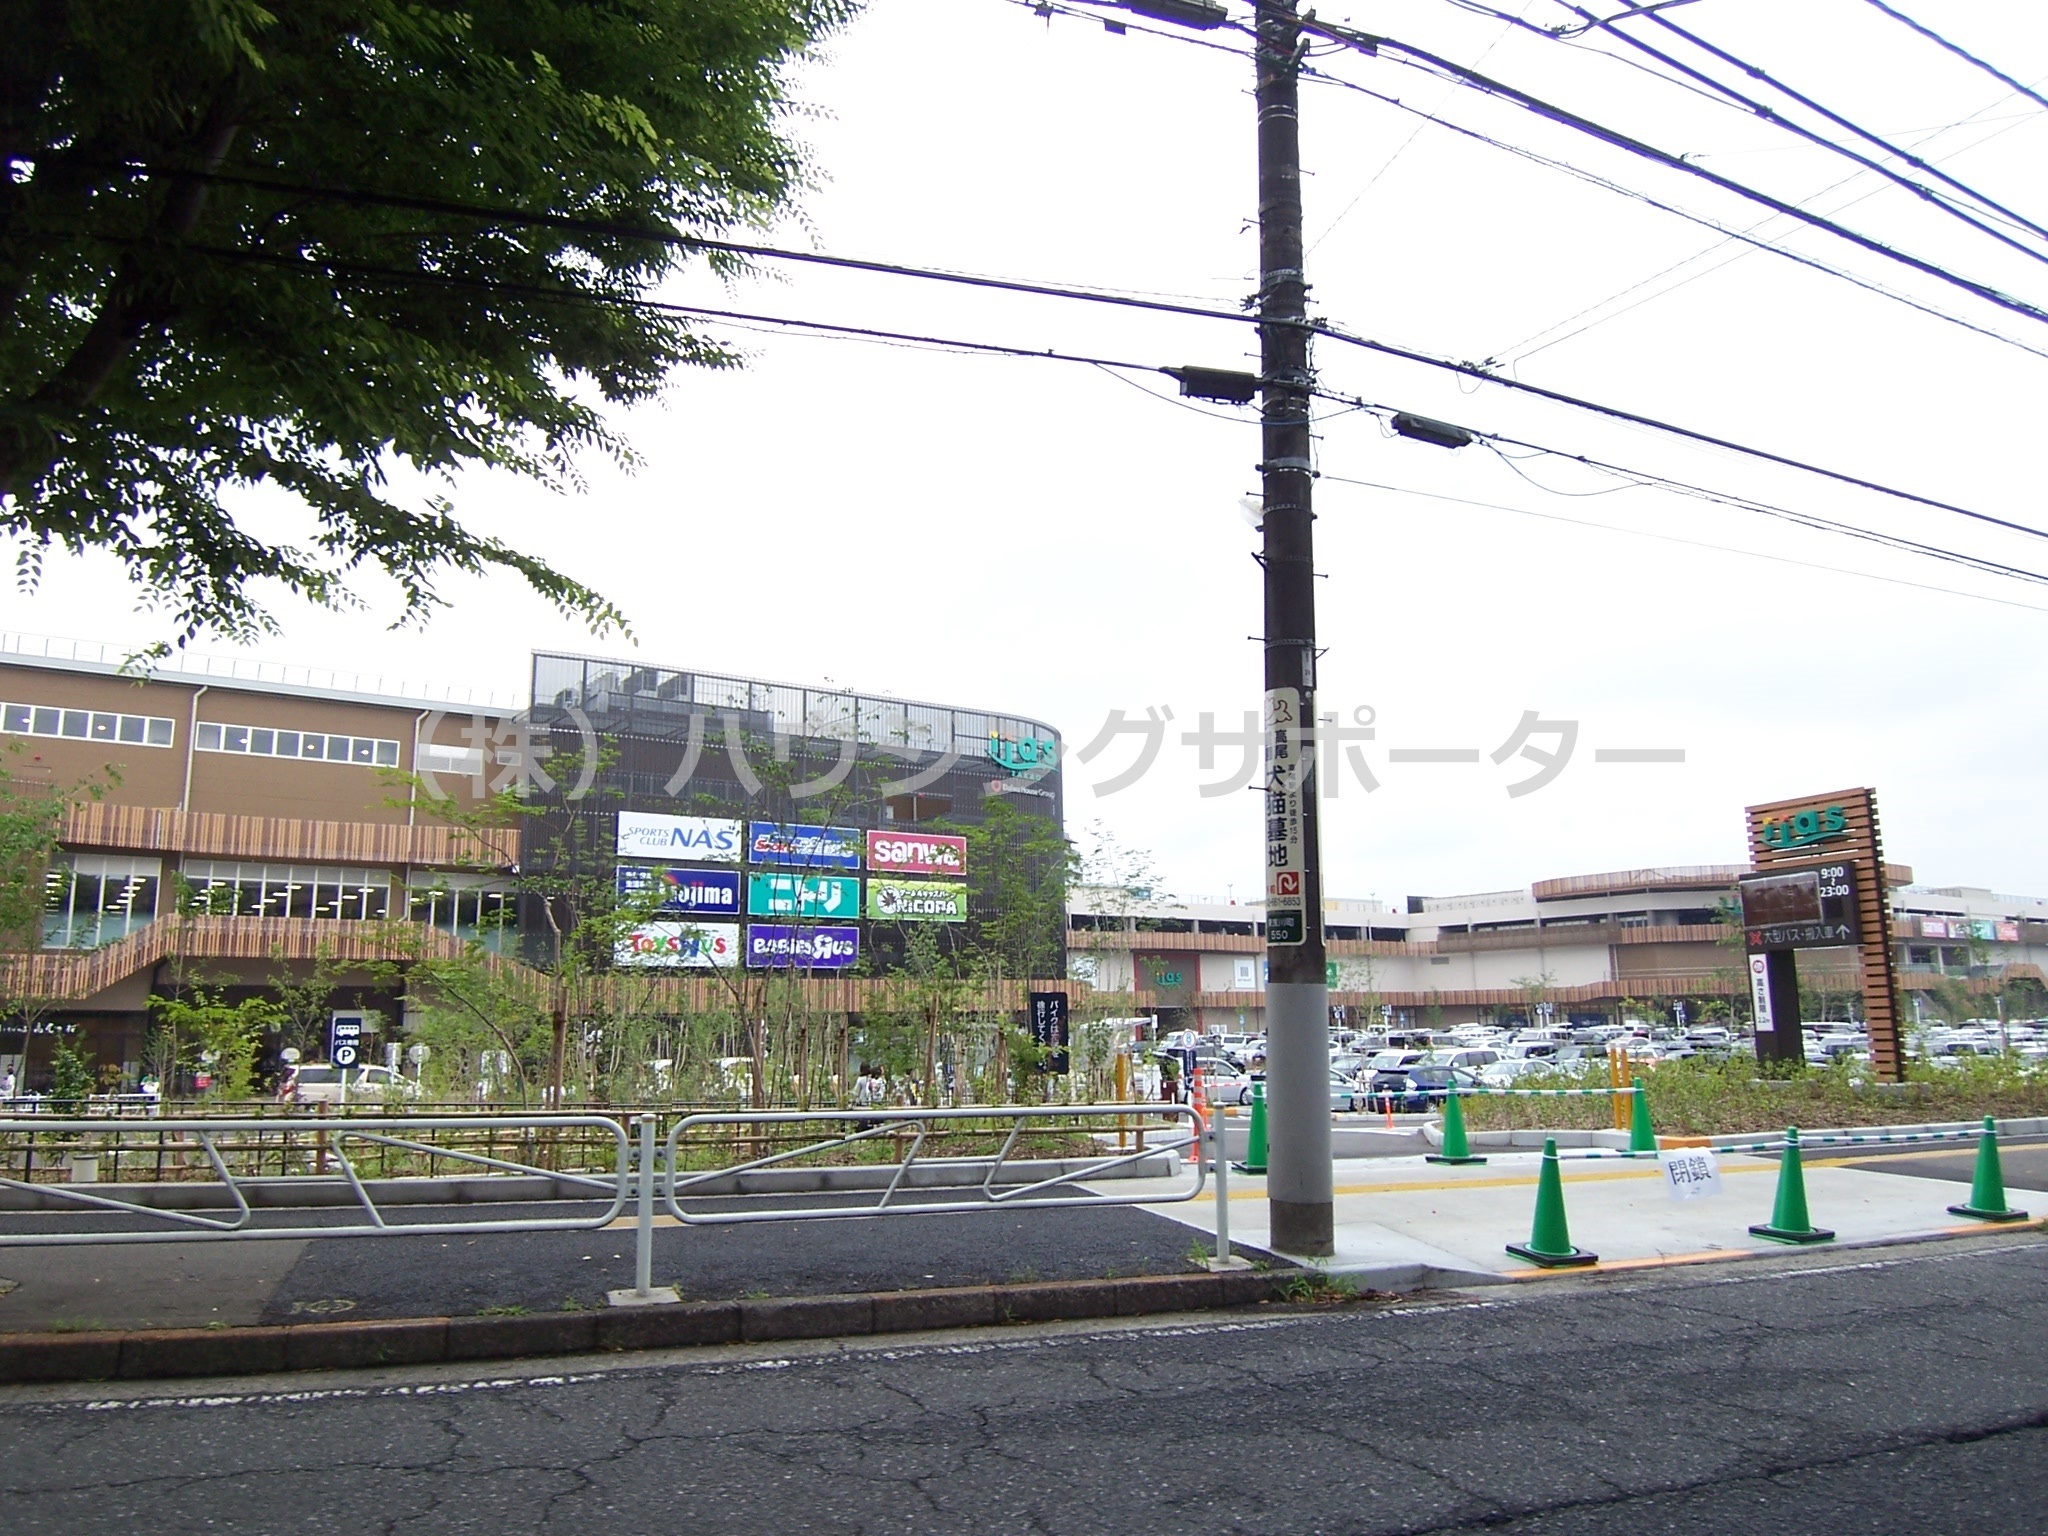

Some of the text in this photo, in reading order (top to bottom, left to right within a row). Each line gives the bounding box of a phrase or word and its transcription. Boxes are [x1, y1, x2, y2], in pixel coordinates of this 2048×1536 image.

[628, 826, 670, 837] SPORTS
[1761, 805, 1845, 846] iias
[639, 836, 668, 846] CLUB
[670, 827, 734, 850] NAS
[1820, 866, 1844, 879] 9:00
[768, 877, 841, 913] ニトリ
[1820, 884, 1849, 898] 23:00
[1270, 930, 1289, 940] 550
[341, 1050, 352, 1061] P
